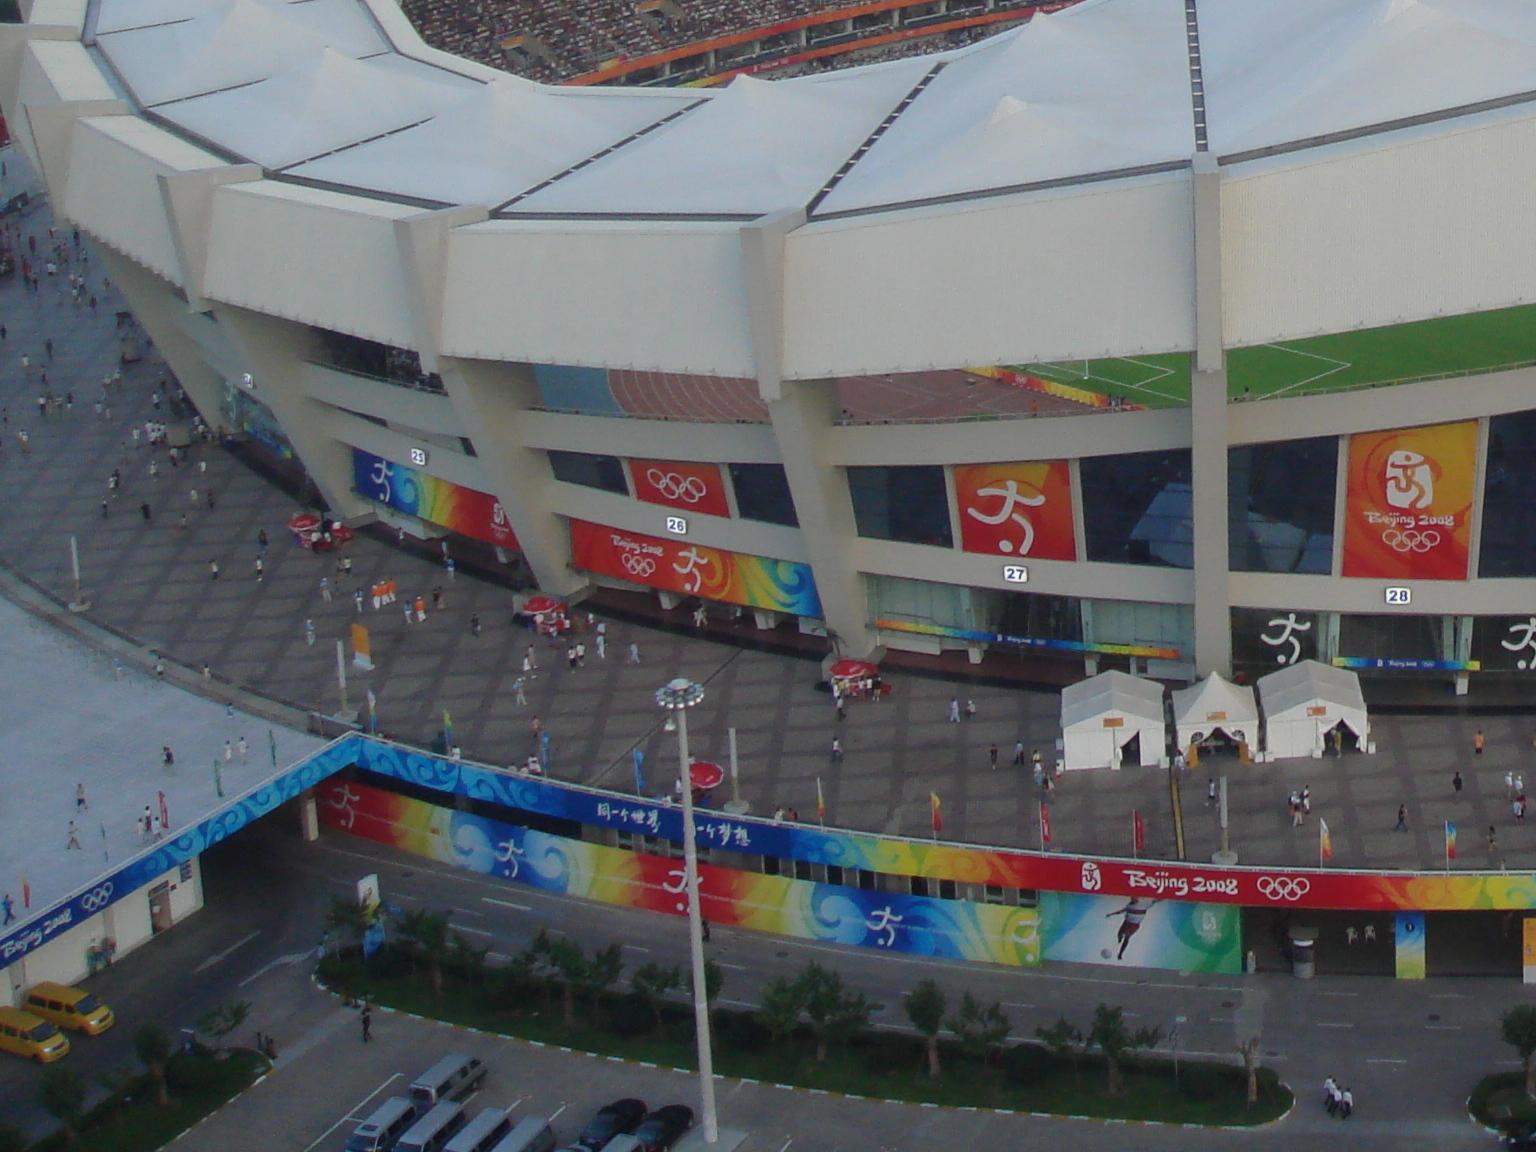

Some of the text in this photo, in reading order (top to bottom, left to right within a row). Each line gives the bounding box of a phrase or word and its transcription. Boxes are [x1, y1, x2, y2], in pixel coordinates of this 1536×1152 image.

[412, 450, 424, 463] 25
[668, 518, 684, 532] 26
[1363, 511, 1455, 529] Beijing 2008
[1006, 568, 1025, 580] 27
[1388, 590, 1408, 602] 28
[695, 822, 751, 847] 一个梦想
[1122, 869, 1239, 895] Beijing 2008
